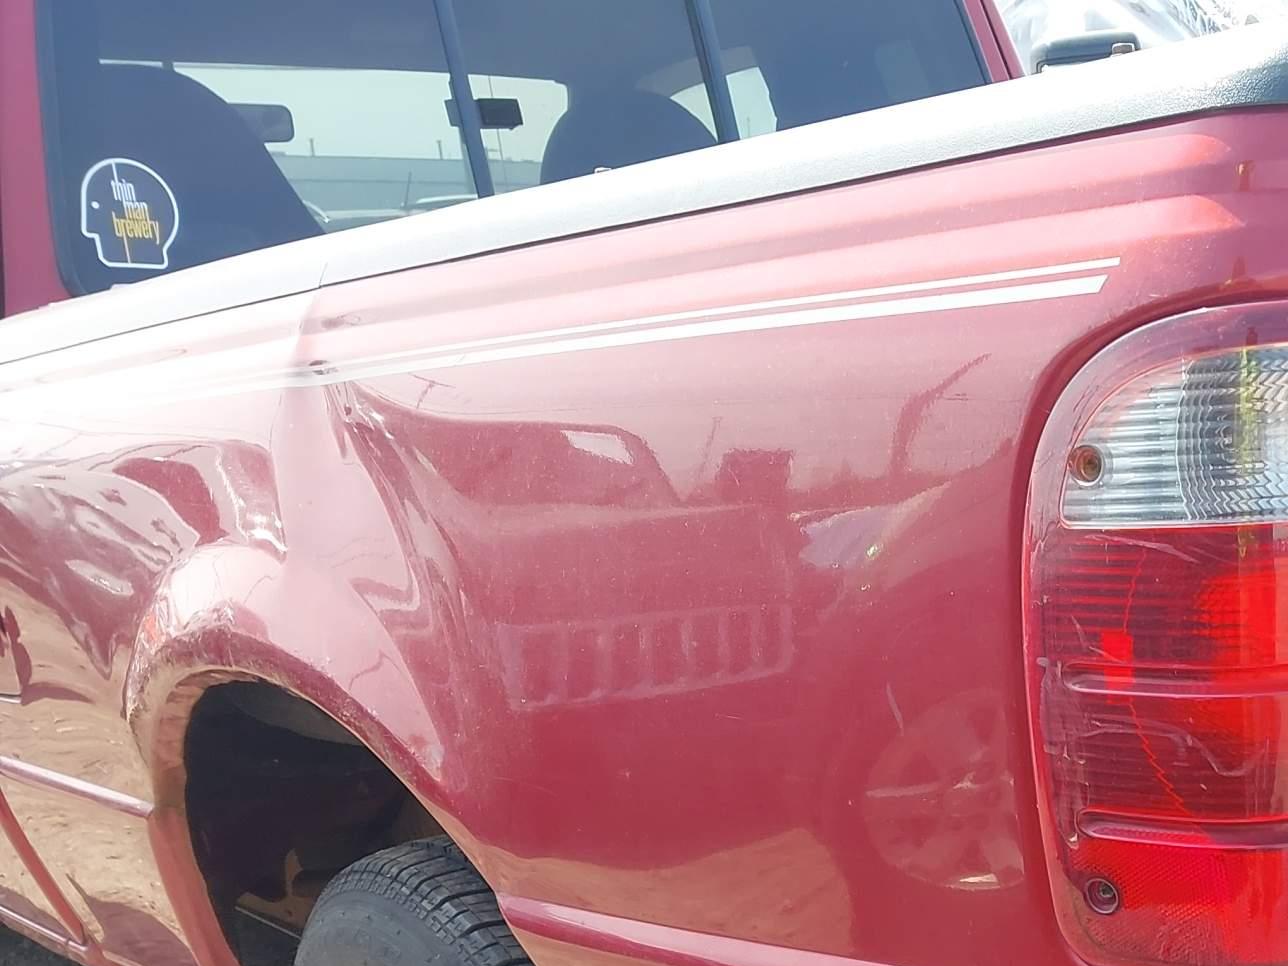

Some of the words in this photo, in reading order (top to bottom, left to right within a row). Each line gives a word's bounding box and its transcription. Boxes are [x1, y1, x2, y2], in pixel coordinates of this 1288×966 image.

[111, 178, 136, 201] thin
[124, 201, 150, 221] man
[112, 211, 160, 245] brewery
